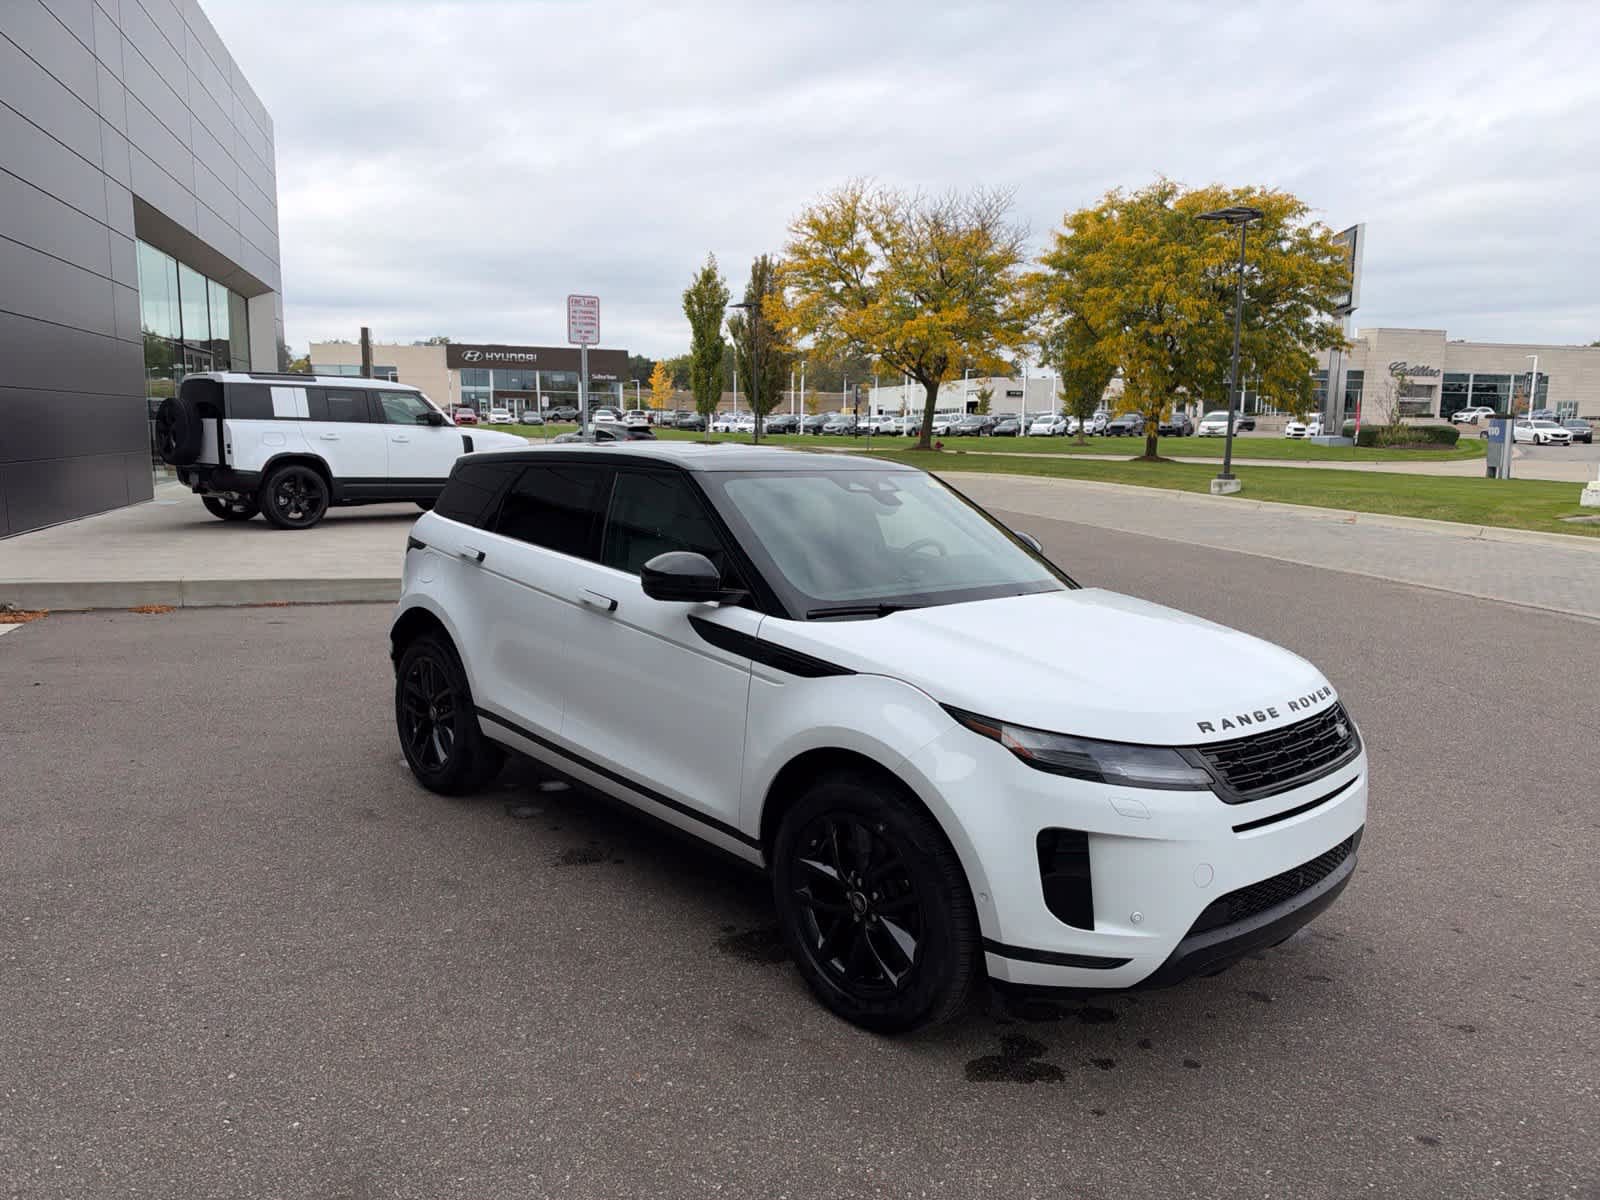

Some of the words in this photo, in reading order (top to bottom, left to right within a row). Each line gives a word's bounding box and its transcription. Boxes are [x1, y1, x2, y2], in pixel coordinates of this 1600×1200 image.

[485, 352, 537, 362] HYUNDAI
[1389, 361, 1441, 377] Cadillac
[1197, 707, 1280, 734] RANGE
[1287, 685, 1332, 712] ROVER
